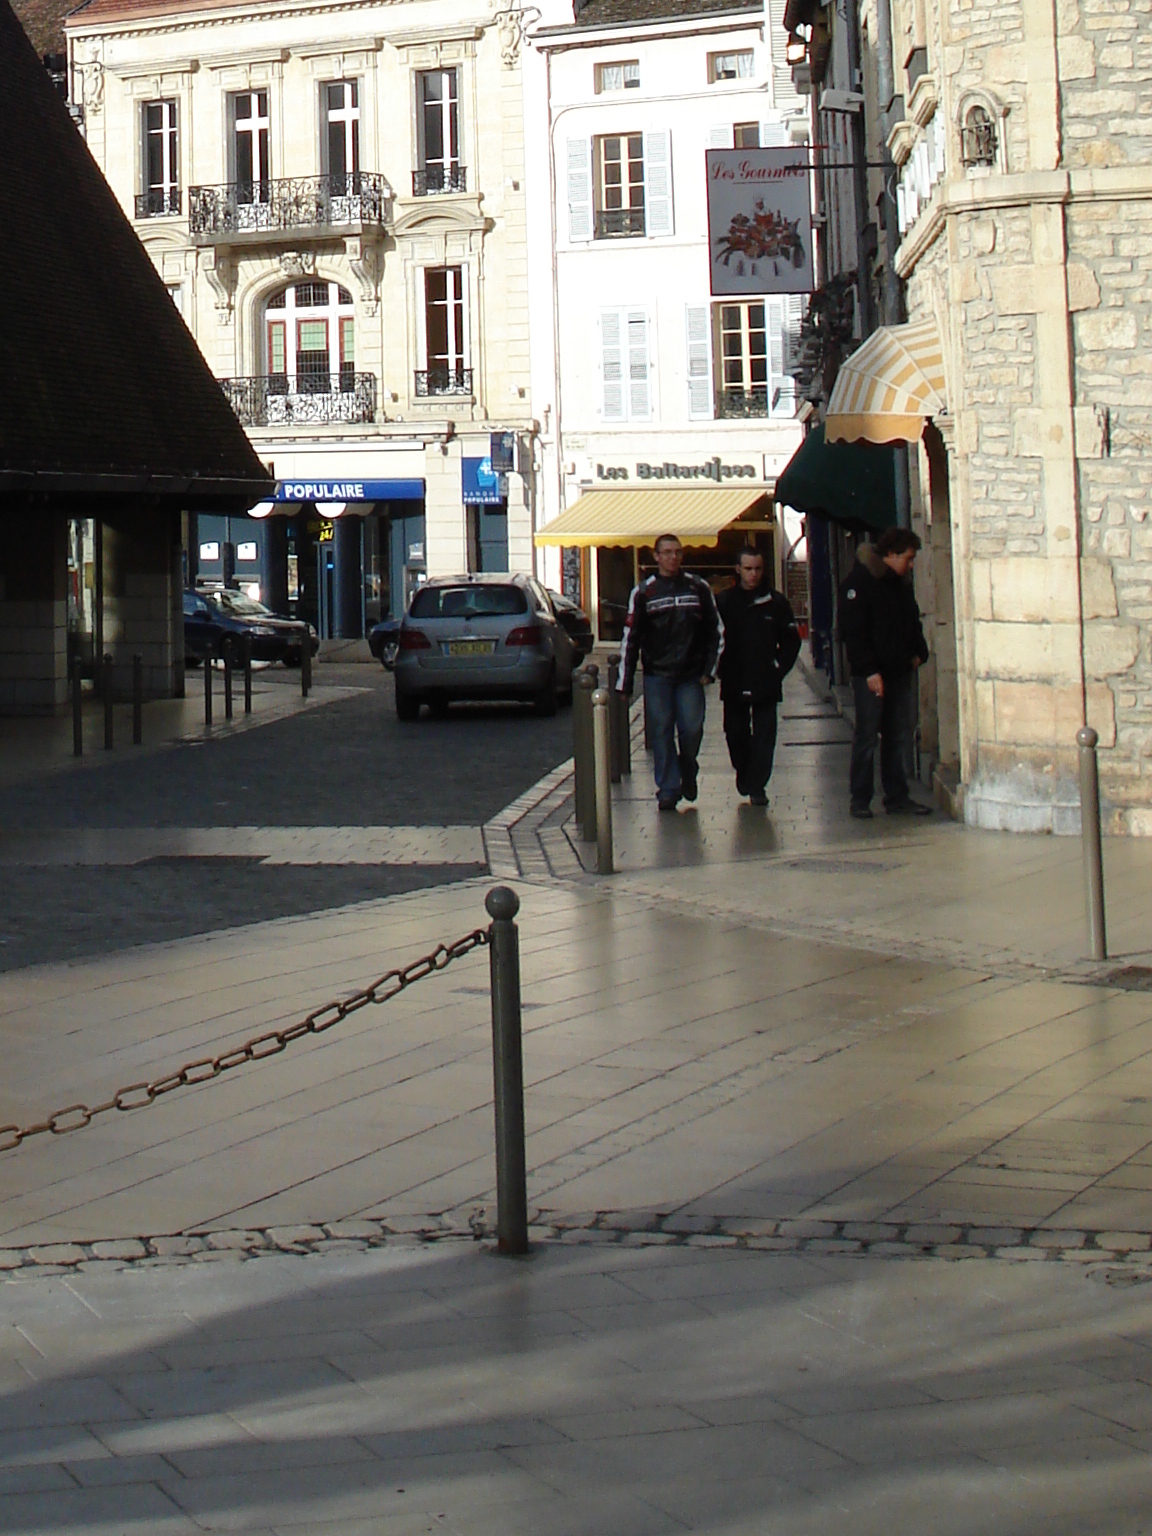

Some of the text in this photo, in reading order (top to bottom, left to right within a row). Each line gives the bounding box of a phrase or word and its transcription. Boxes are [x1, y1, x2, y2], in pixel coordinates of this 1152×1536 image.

[711, 161, 735, 180] Les
[596, 462, 629, 480] Les
[284, 483, 365, 499] POPULAIRE
